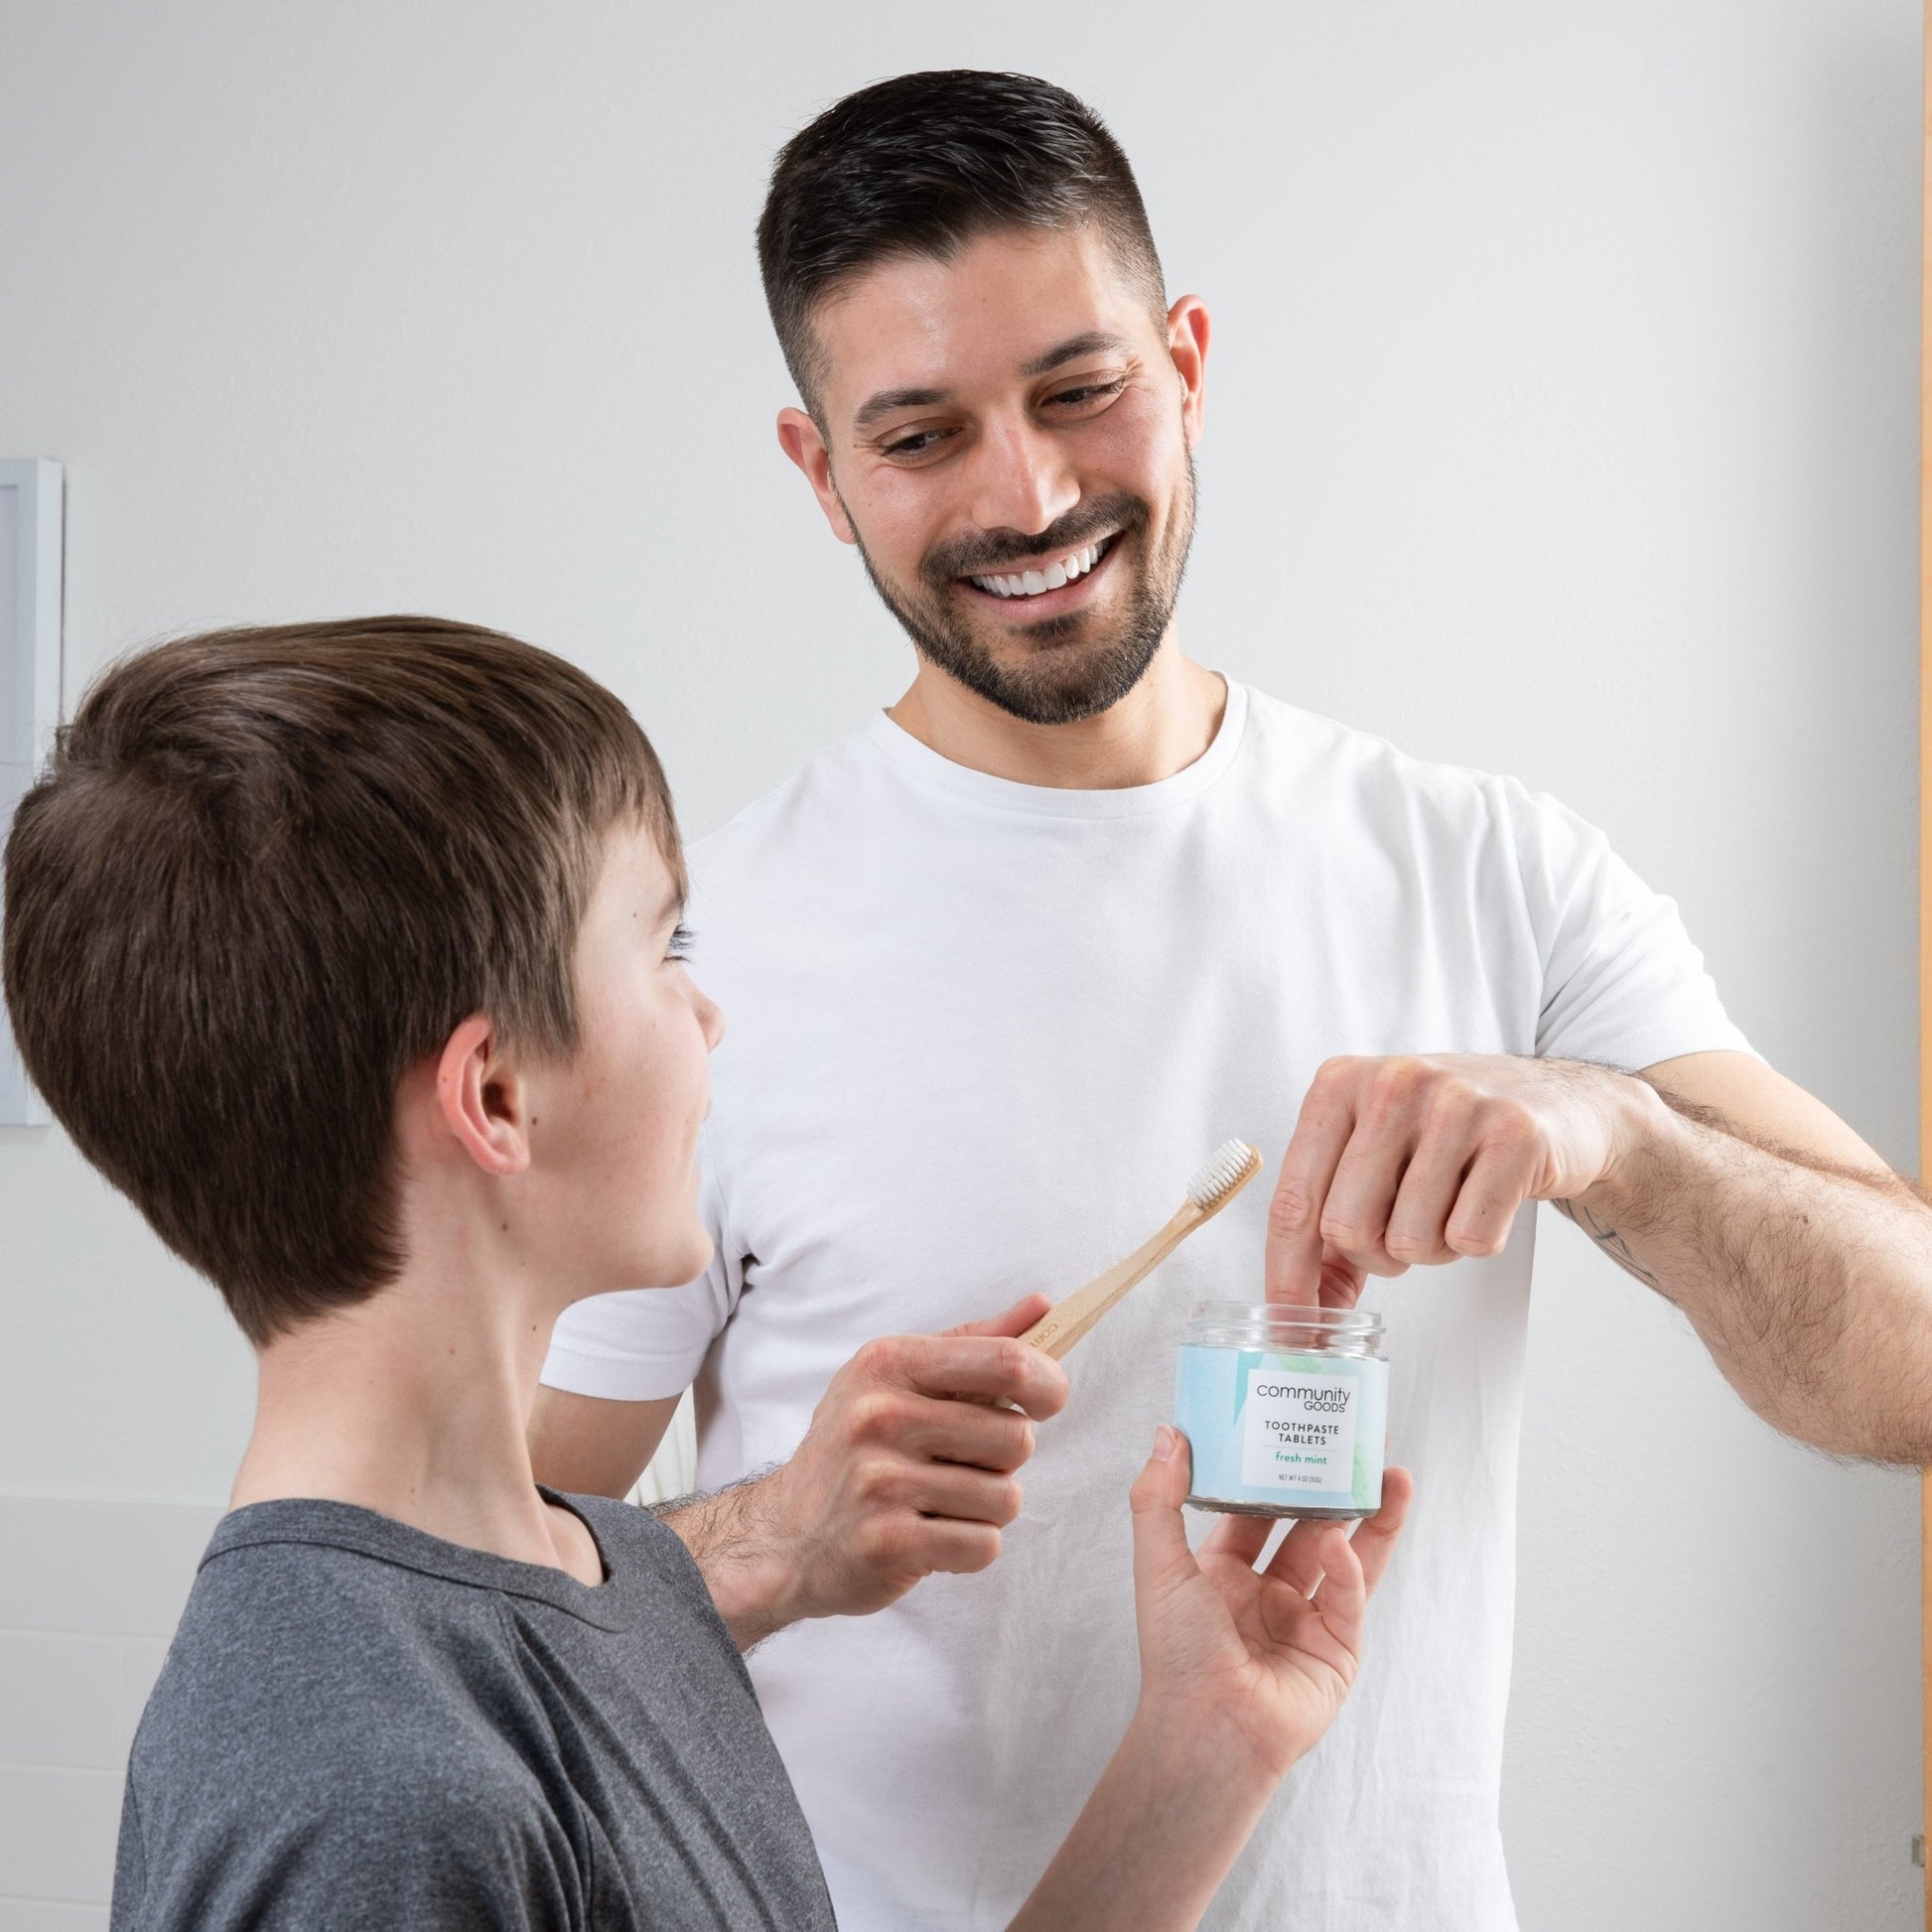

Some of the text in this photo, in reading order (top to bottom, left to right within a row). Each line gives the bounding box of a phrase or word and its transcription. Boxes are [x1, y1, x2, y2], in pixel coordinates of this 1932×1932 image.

[1257, 1385, 1350, 1405] community
[1304, 1401, 1345, 1413] GOODS
[1265, 1421, 1339, 1435] TOOTHPASTE
[1279, 1434, 1326, 1445] TABLETS
[1276, 1451, 1327, 1464] fresh mint
